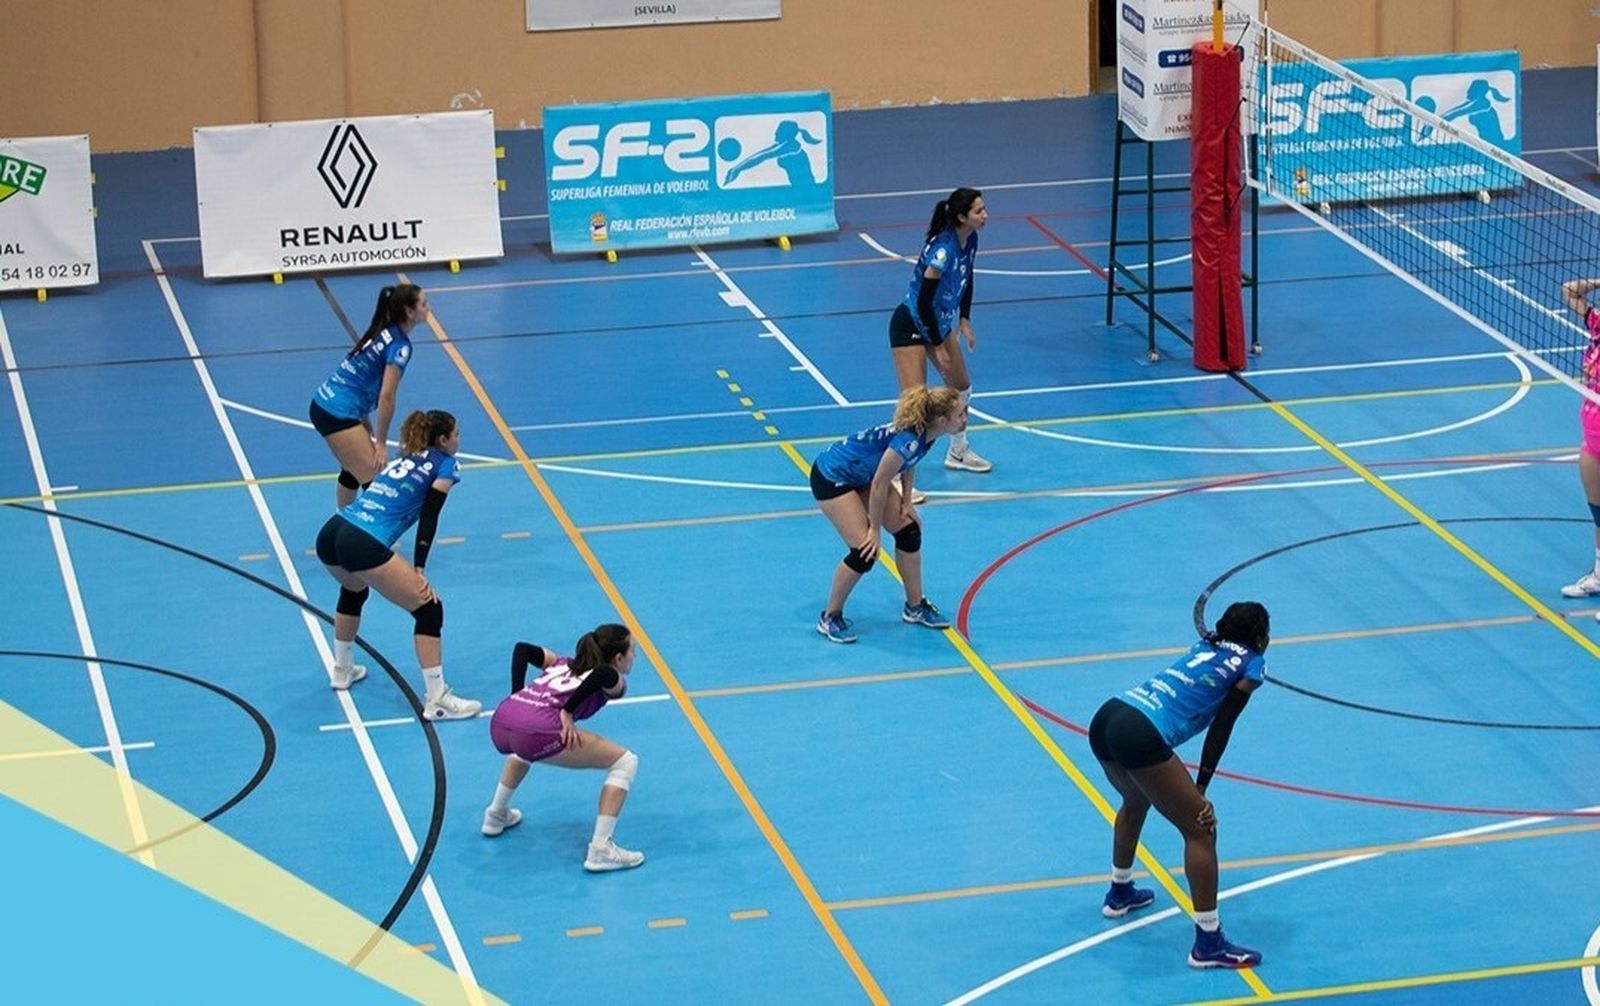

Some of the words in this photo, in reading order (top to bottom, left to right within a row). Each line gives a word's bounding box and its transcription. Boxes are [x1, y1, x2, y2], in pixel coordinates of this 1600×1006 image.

[634, 4, 676, 16] (SEVILLA)
[552, 119, 710, 181] SF-2
[0, 159, 43, 193] RE
[550, 186, 602, 201] SUPERLIGA
[603, 184, 652, 198] FEMENINA
[653, 183, 666, 194] DE
[666, 179, 710, 193] VOLEIBOL
[610, 218, 633, 232] REAL
[635, 214, 693, 230] FEDERACIÓN
[694, 211, 739, 227] ESPAÑOLA
[740, 212, 753, 223] DE
[754, 208, 797, 222] VOLEIBOL
[280, 219, 423, 248] RENAULT
[282, 253, 328, 268] SYRSA
[330, 245, 427, 265] AUTOMOCIÓN
[25, 266, 44, 279] 18
[49, 264, 68, 278] 02
[72, 262, 91, 277] 97
[379, 458, 416, 480] 13
[1186, 651, 1216, 669] 1
